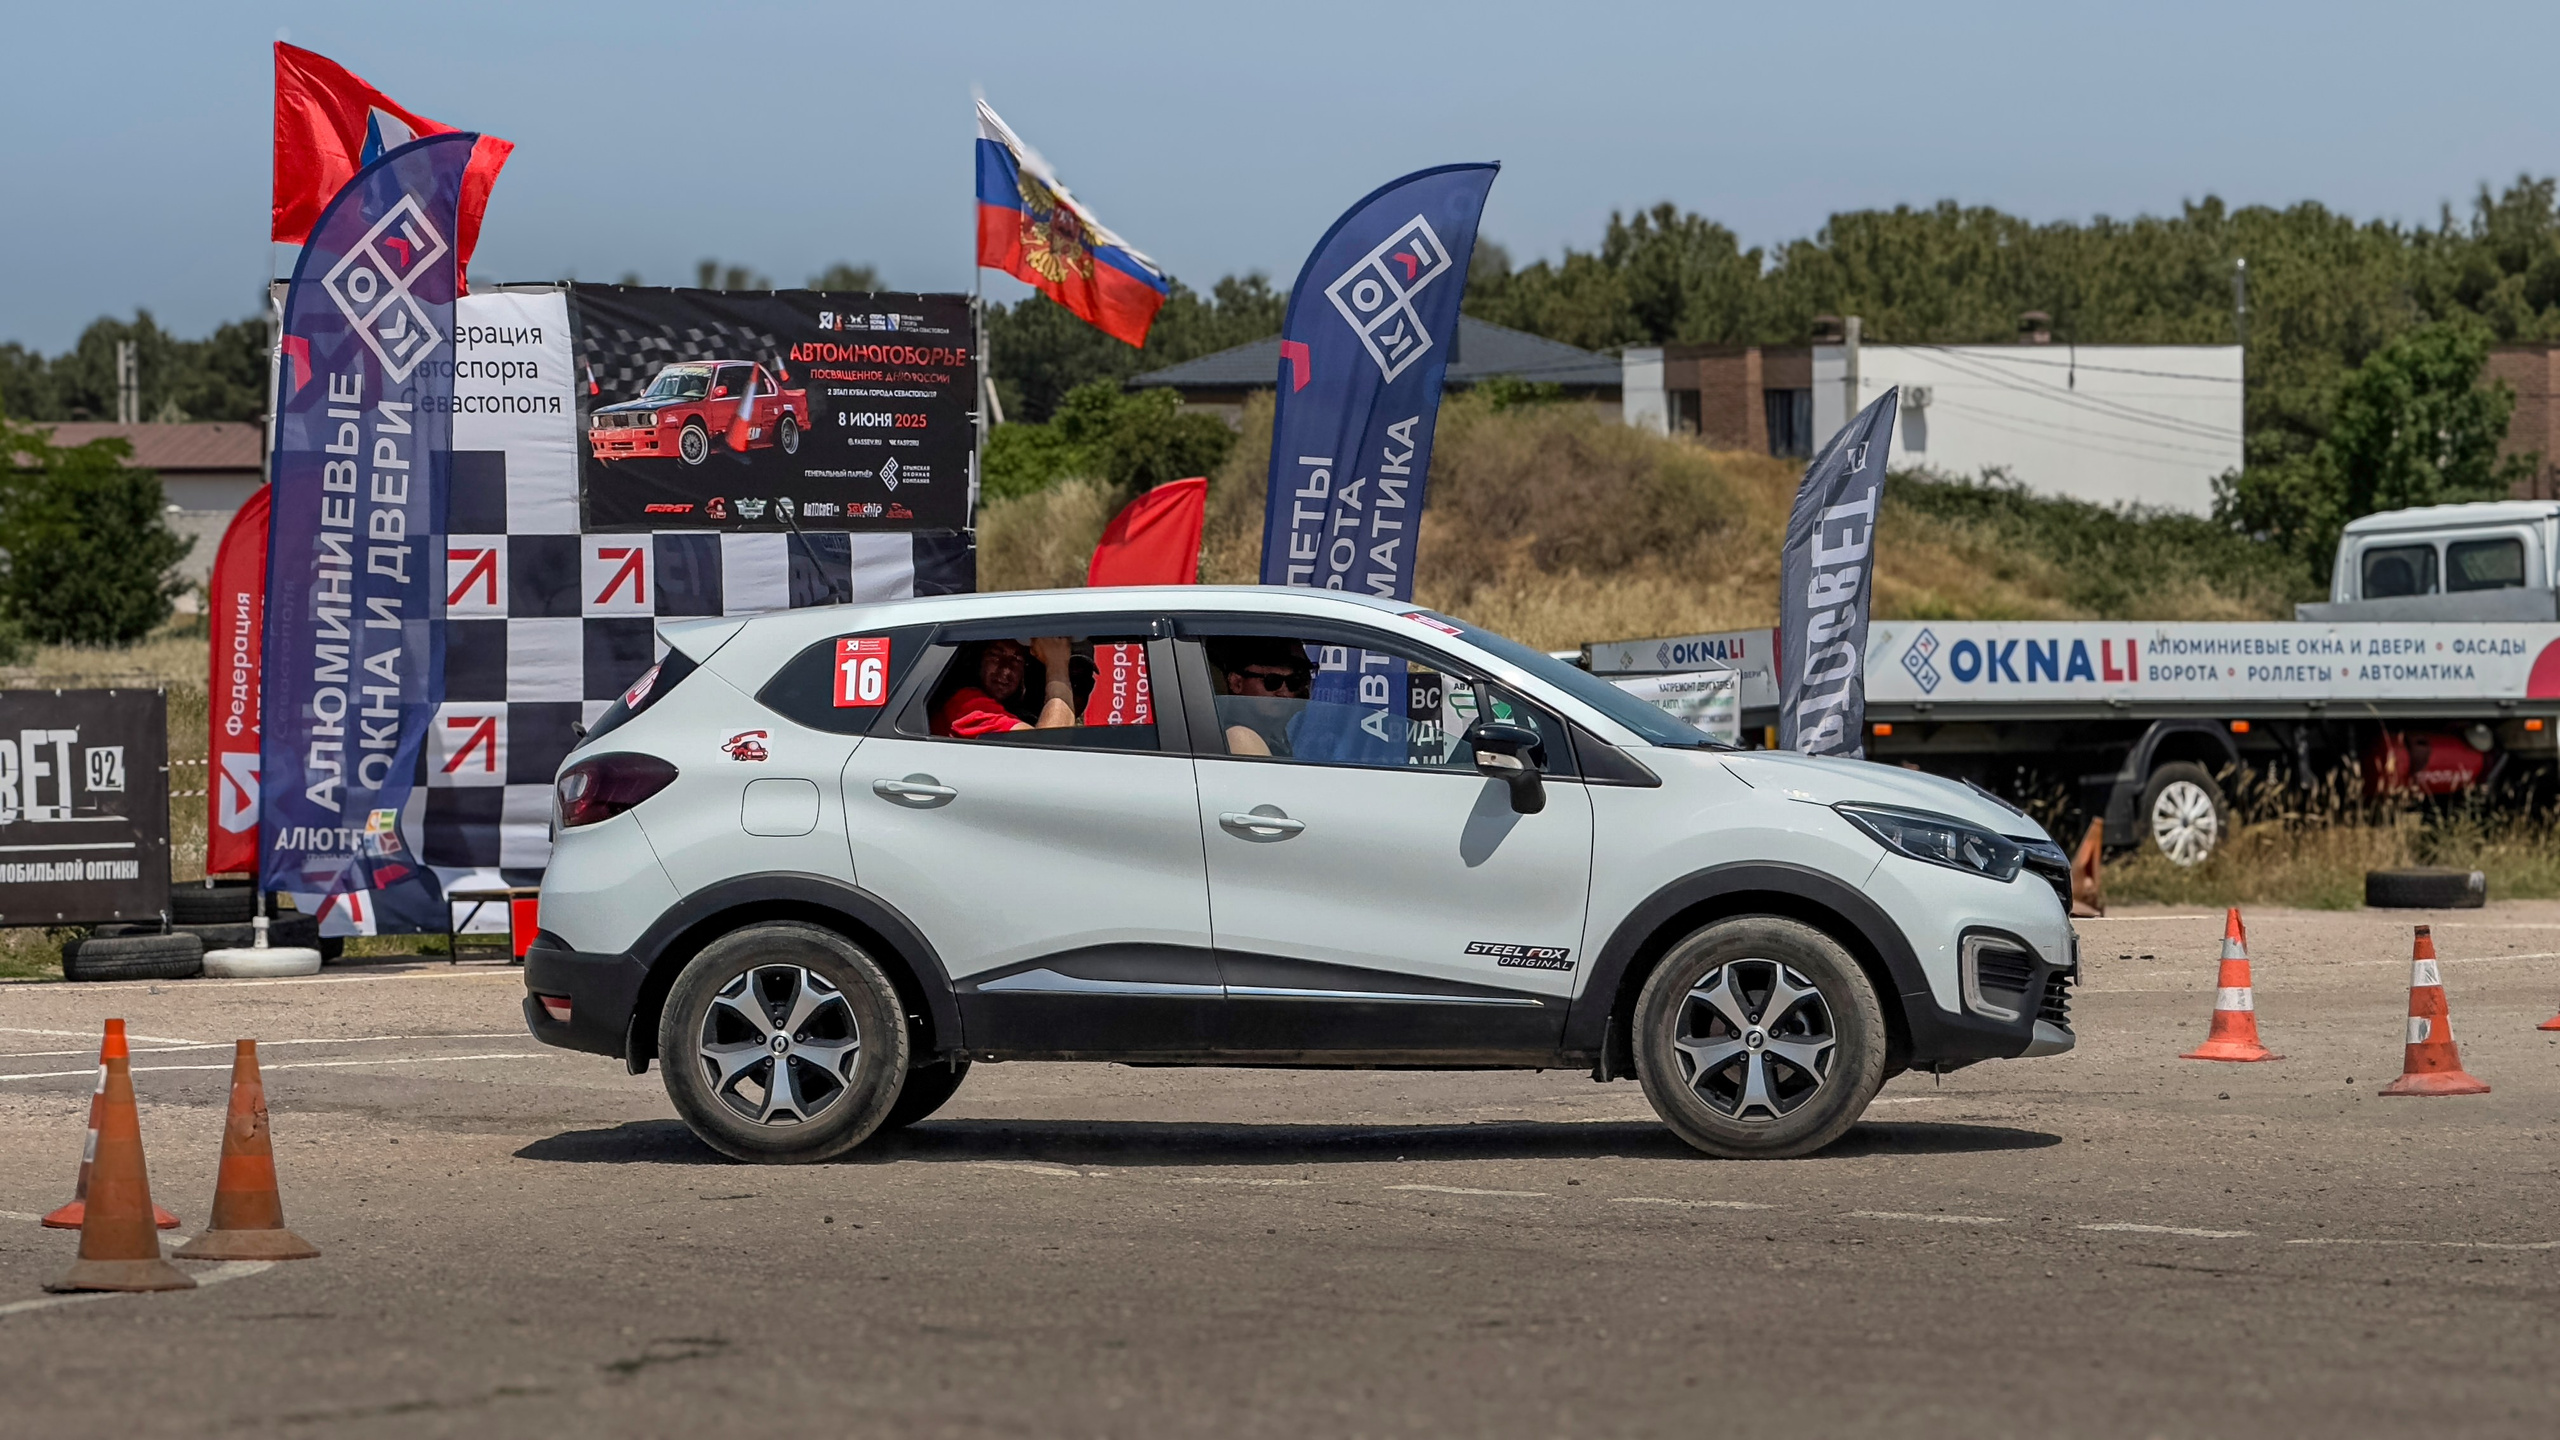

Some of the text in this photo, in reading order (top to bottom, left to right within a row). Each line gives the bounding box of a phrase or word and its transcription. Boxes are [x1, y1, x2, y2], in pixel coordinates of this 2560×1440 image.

[789, 342, 966, 367] АВТОМНОГОБОРЬЕ
[810, 369, 883, 382] ПОСВЯЩЕННОЕ
[912, 373, 950, 384] РОССИИ
[827, 388, 832, 396] 2
[849, 388, 868, 396] КУБКА
[869, 389, 893, 397] ГОРОДА
[838, 412, 927, 428] 8 ИЮНЯ 2025
[804, 469, 847, 478] ГЕНЕРАЛЬНЫЙ
[306, 372, 362, 813] АЛЮМИНИЕВЫЕ
[358, 400, 412, 791] ОКНА И ДВЕРИ
[1673, 638, 1745, 664] OKNALI
[2148, 638, 2526, 657] АЛЮМИНИЕВЫЕ ОКНА И ДВЕРИ ФАСАДЫ
[225, 592, 252, 737] Федерация
[1950, 639, 2138, 683] OKNALI
[841, 657, 882, 702] 16
[2149, 664, 2475, 681] ВОРОТА РОЛЛЕТЫ АВТОМАТИКА
[1658, 682, 1696, 693] КАПРЕМОНТ
[91, 750, 117, 788] 92
[86, 860, 139, 881] ОПТИКИ
[1467, 943, 1566, 959] STEEL FOX
[1499, 956, 1570, 970] ORIGINAL
